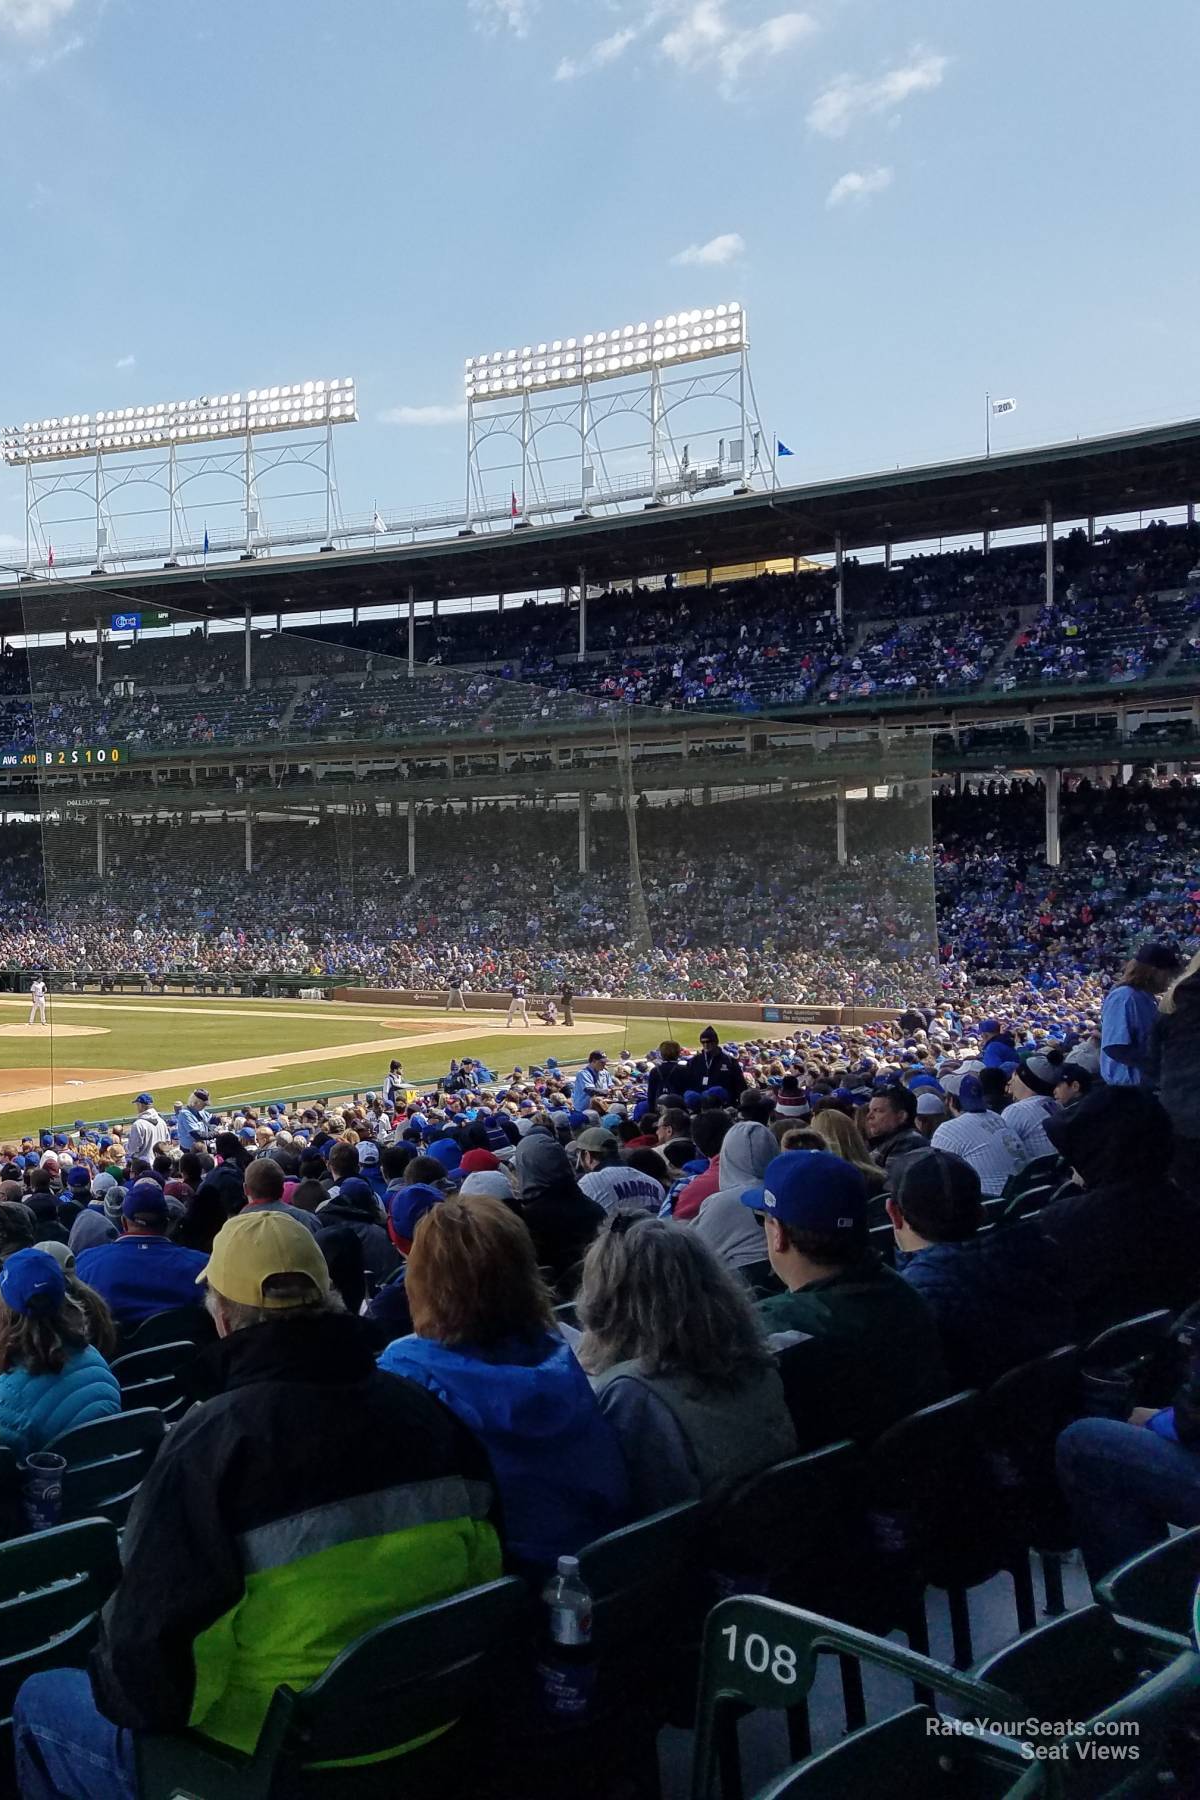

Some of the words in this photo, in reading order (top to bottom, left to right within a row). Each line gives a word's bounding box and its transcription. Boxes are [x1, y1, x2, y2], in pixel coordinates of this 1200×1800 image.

[2, 756, 17, 764] AVG
[20, 754, 36, 764] .410
[46, 752, 52, 764] B
[58, 752, 65, 764] 2
[72, 751, 78, 762] S
[86, 750, 92, 762] 1
[112, 749, 118, 760] 0
[722, 1624, 796, 1684] 108
